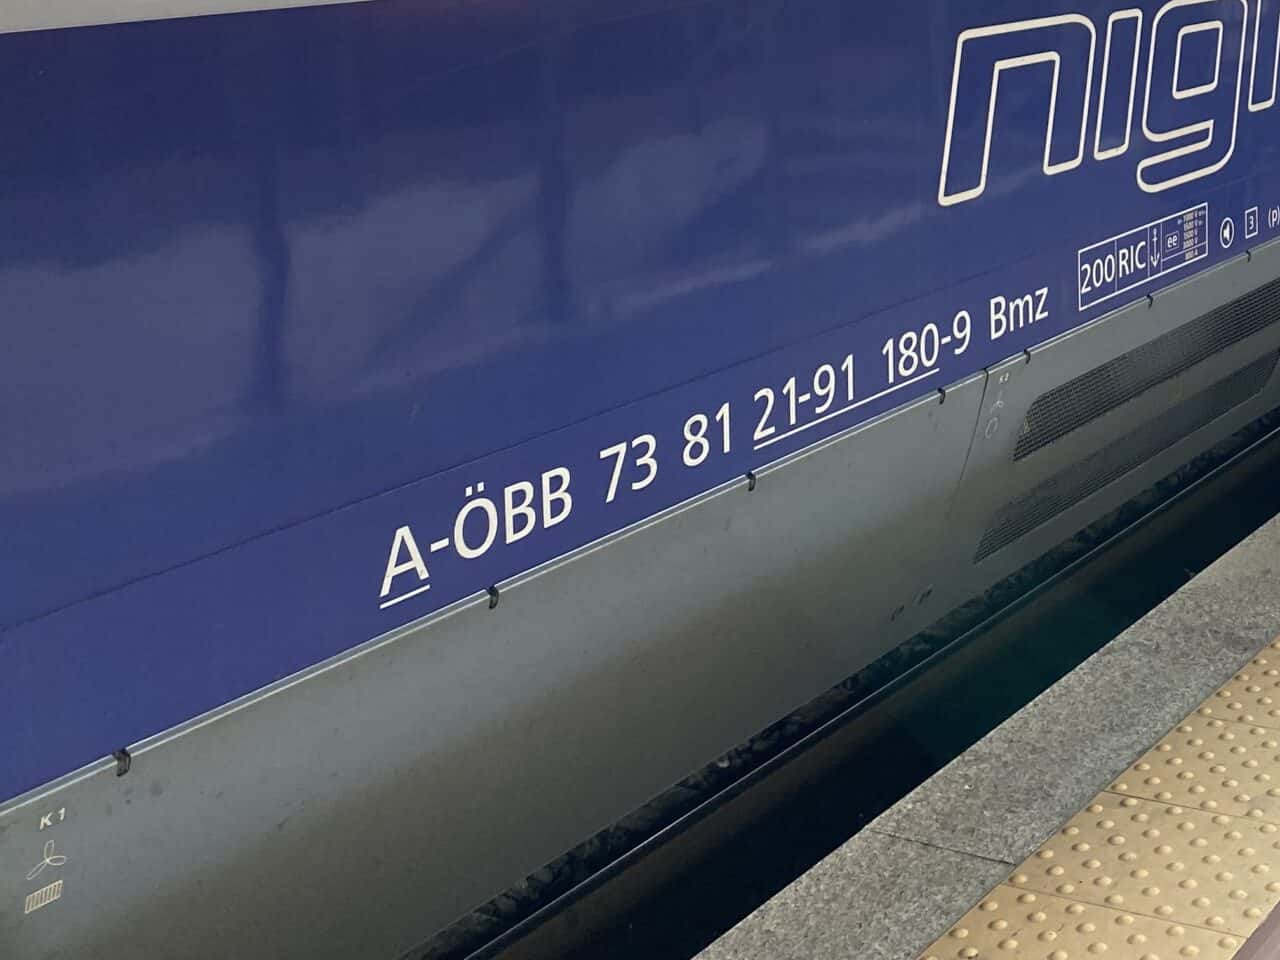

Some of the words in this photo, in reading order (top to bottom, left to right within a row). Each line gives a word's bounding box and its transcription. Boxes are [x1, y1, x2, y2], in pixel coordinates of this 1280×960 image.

[1080, 253, 1116, 294] 200
[1118, 241, 1147, 278] RIC
[380, 465, 574, 597] A-ÖBB
[599, 434, 658, 503] 73
[682, 402, 734, 467] 81
[752, 354, 855, 442] 21-91
[882, 310, 971, 385] 180-9
[989, 286, 1049, 341] Bmz
